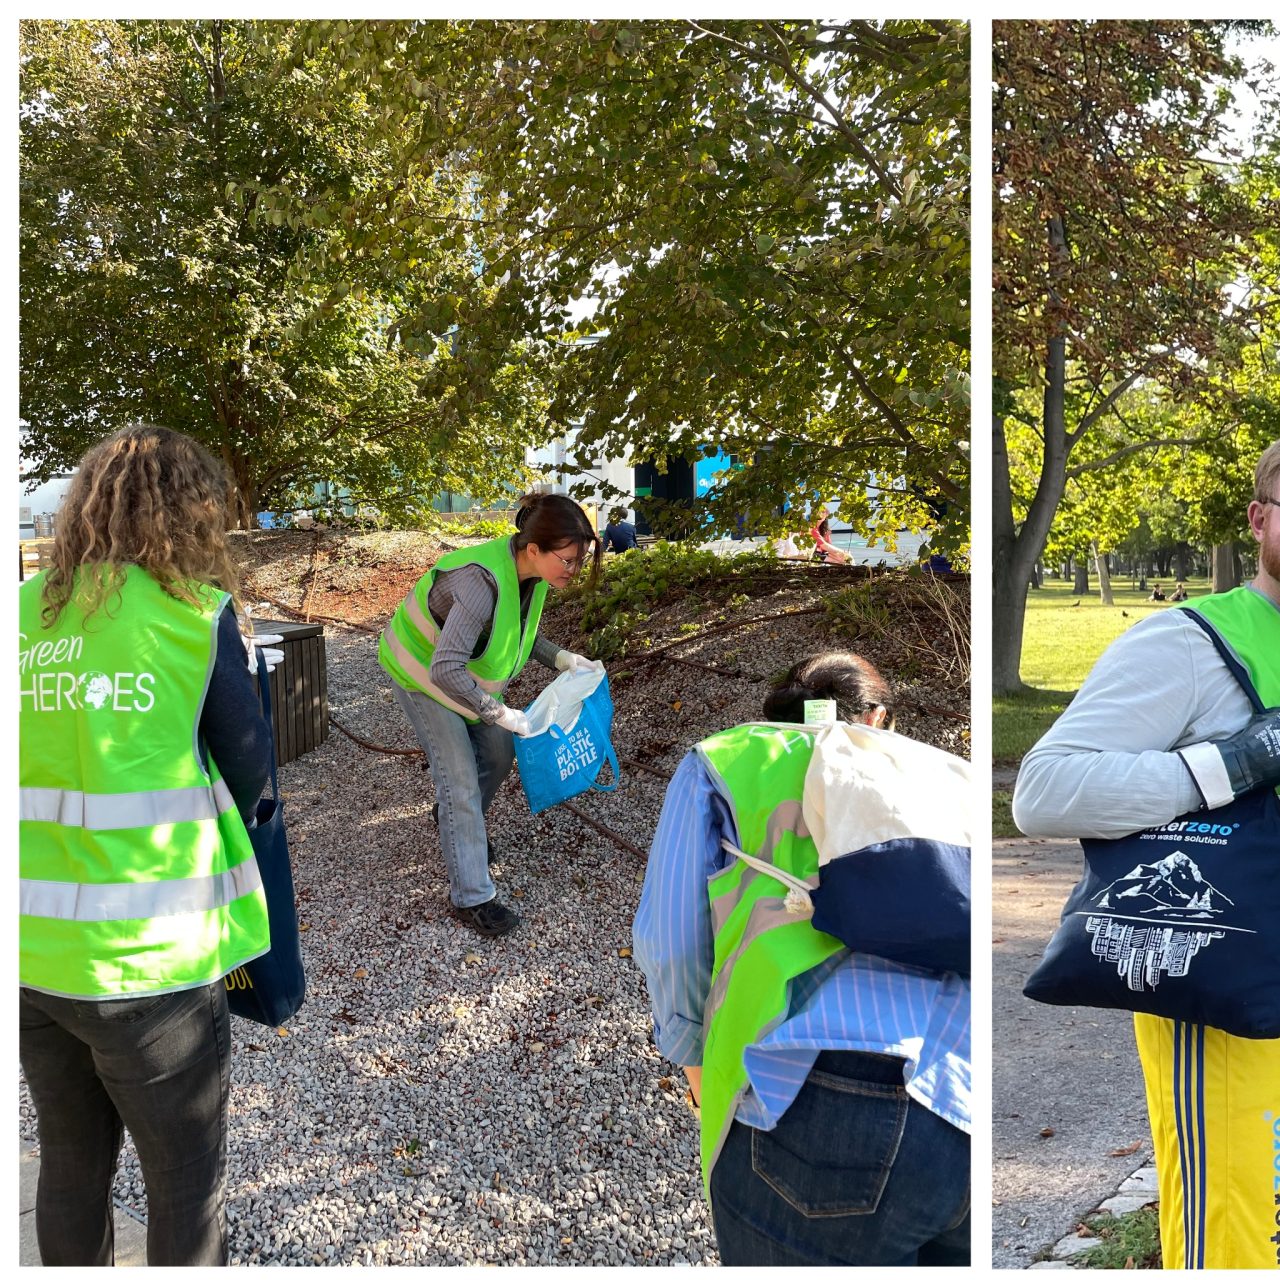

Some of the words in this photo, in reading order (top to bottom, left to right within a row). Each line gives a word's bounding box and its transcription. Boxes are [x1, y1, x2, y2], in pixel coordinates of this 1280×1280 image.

[568, 735, 576, 744] TO
[576, 730, 583, 739] BE
[584, 727, 588, 735] A
[556, 733, 594, 770] PLASTIC
[1157, 833, 1183, 842] waste
[1183, 835, 1228, 846] solutions
